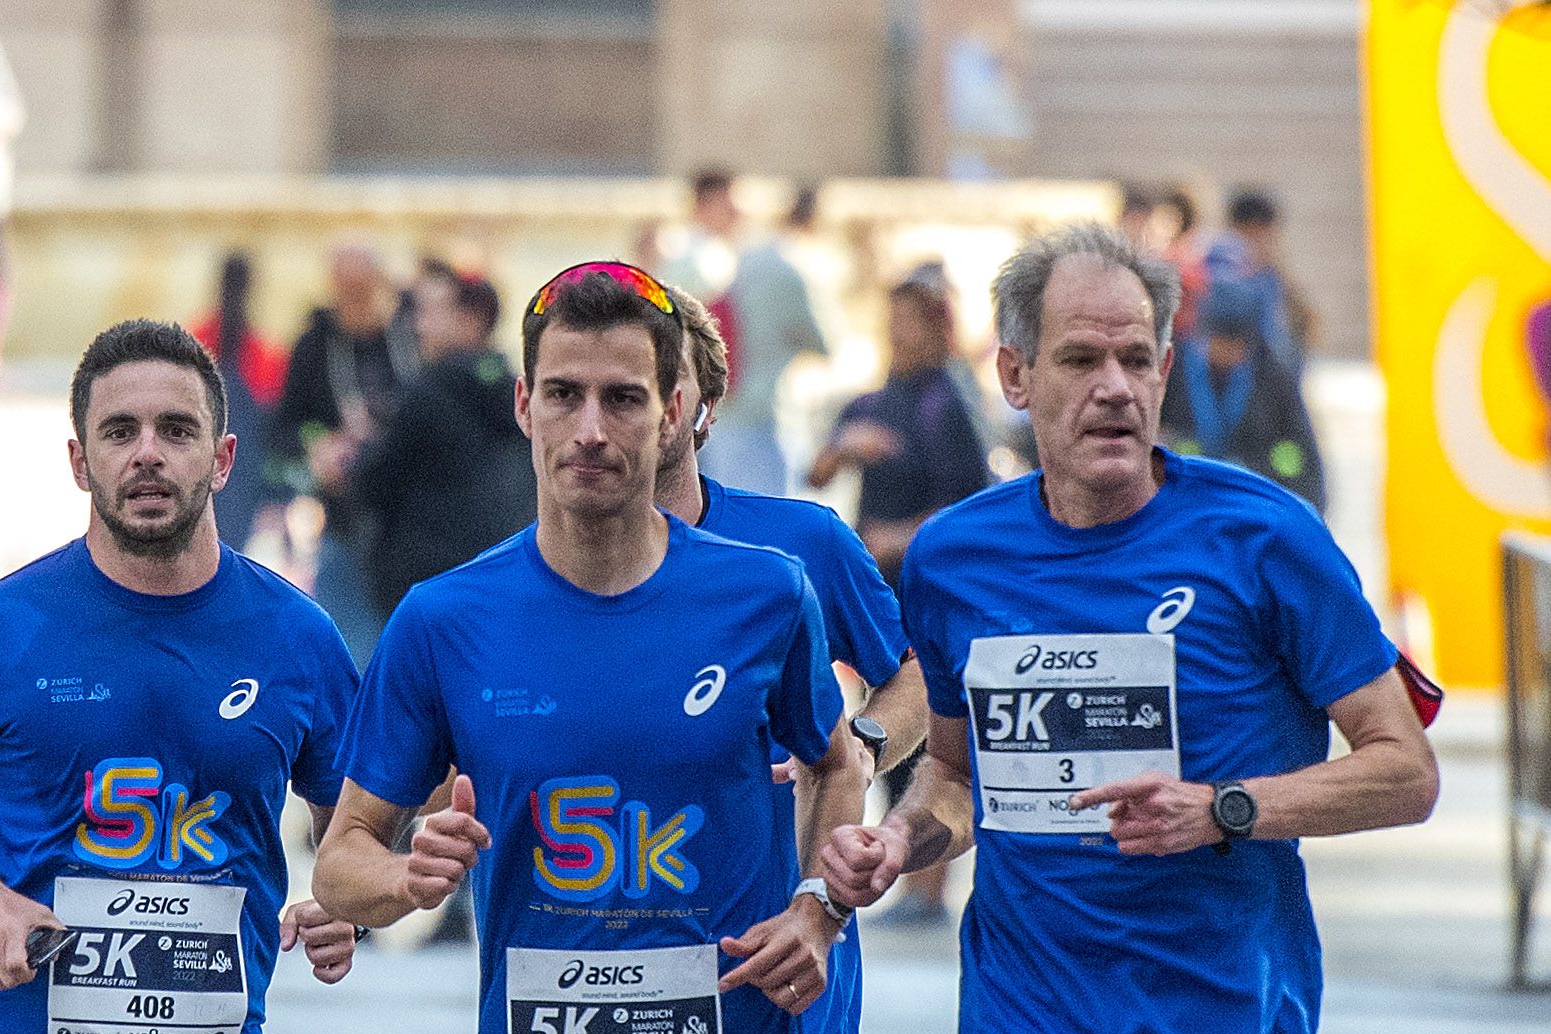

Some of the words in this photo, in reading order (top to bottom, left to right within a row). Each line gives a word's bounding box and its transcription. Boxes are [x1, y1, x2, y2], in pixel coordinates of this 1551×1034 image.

[1042, 650, 1098, 670] asics
[50, 677, 82, 686] ZURICH
[50, 694, 85, 703] SEVILLA
[1085, 695, 1126, 706] ZURICH
[985, 692, 1055, 741] 5K
[1084, 717, 1128, 728] SEVILLA
[1059, 758, 1074, 783] 3
[135, 896, 190, 915] asics
[175, 938, 208, 950] ZURICH
[69, 932, 147, 978] 5K
[173, 959, 208, 970] SEVILLA
[172, 970, 196, 981] 2022
[585, 965, 644, 985] asics
[71, 976, 118, 986] BREAKFAST
[118, 978, 137, 988] RUN
[126, 995, 175, 1020] 408
[632, 1009, 673, 1020] ZURICH
